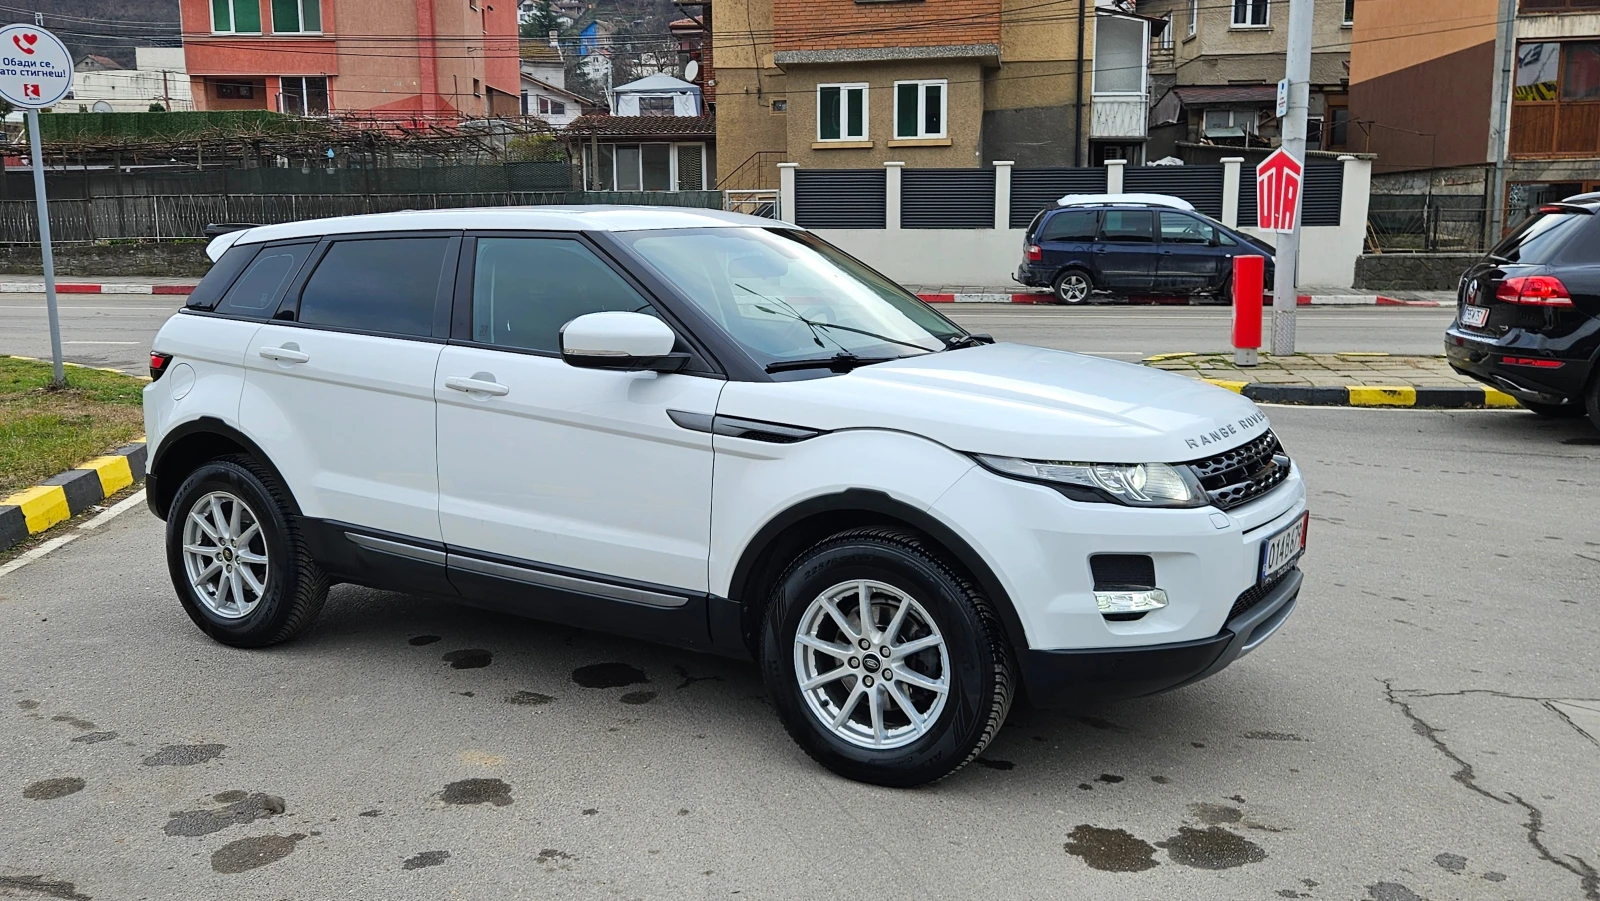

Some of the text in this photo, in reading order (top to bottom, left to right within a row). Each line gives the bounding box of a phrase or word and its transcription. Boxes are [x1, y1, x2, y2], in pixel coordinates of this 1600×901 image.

[3, 57, 54, 69] Обади се,
[20, 69, 66, 77] стигнеш!
[1184, 424, 1237, 449] RANGE
